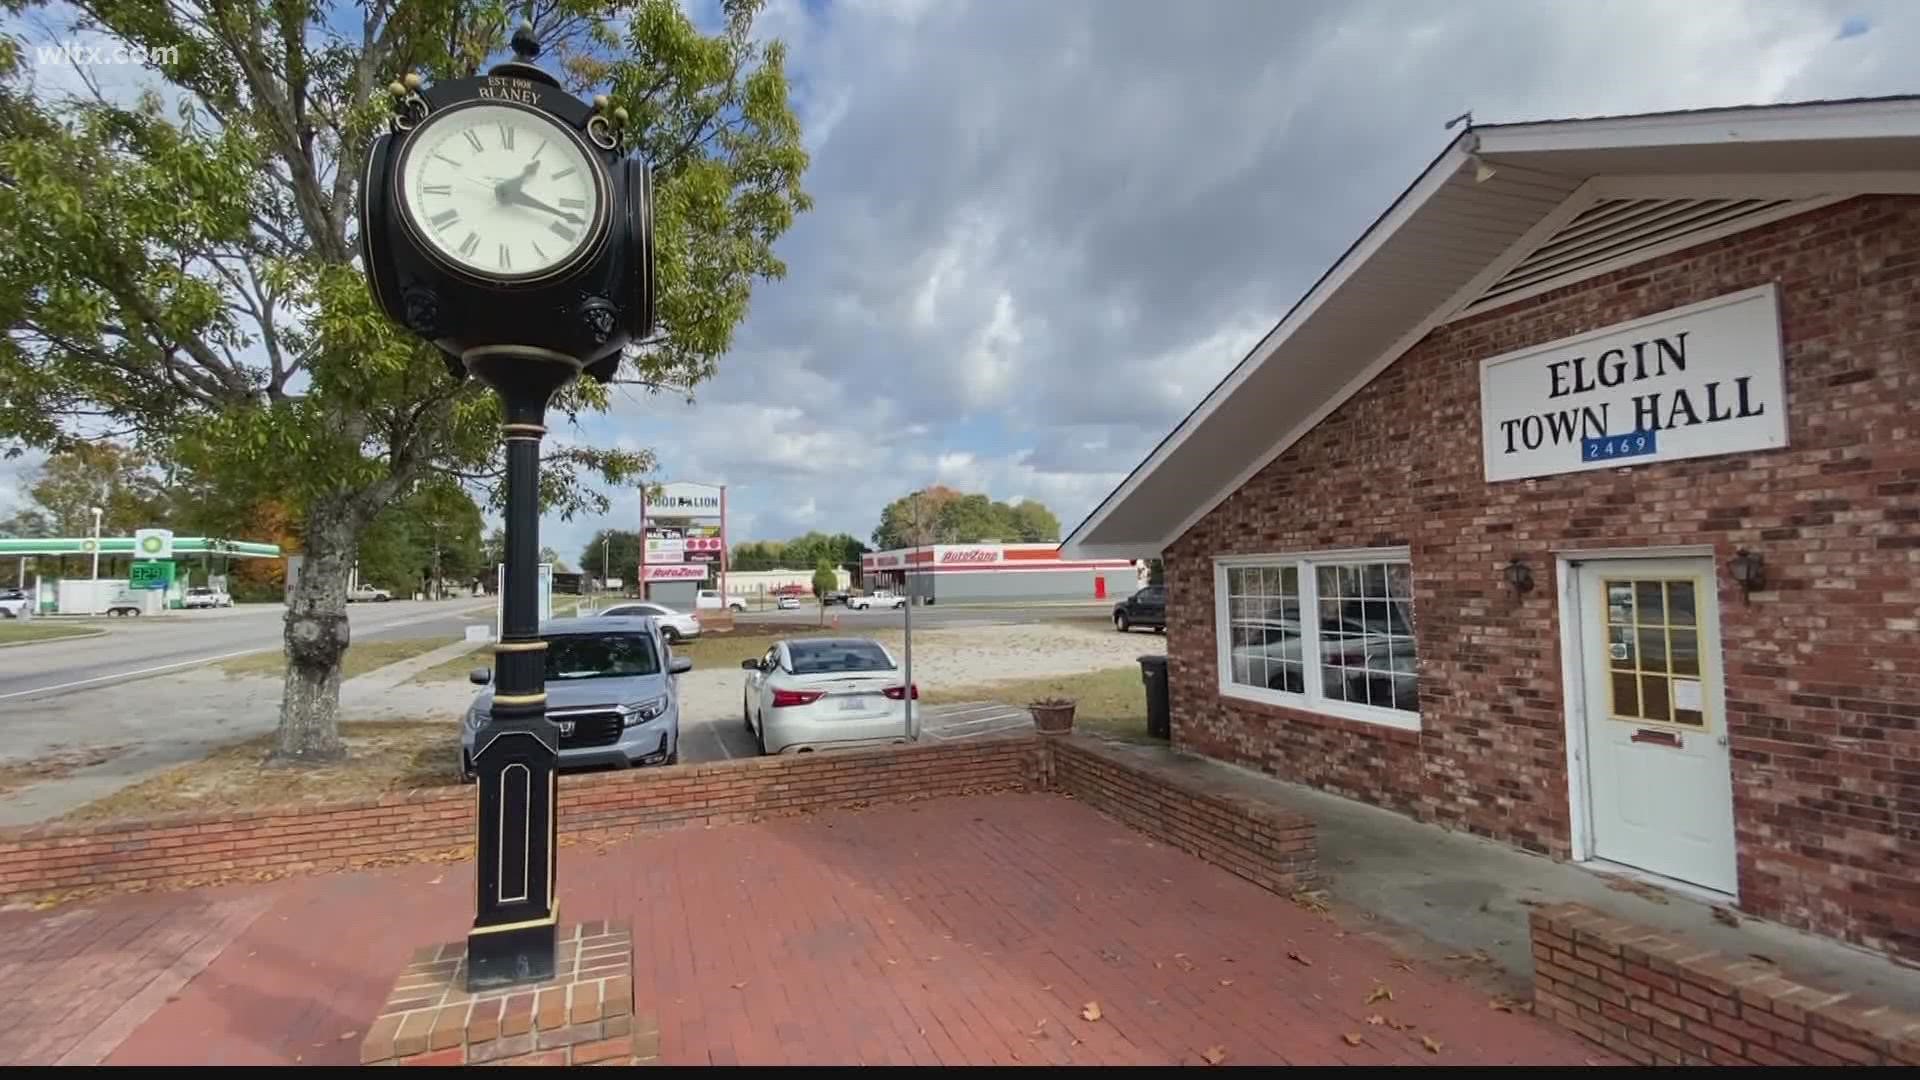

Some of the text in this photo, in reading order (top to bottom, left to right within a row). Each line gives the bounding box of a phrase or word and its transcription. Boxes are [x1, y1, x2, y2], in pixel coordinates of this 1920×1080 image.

[479, 87, 541, 105] BLANEY
[1546, 332, 1690, 399] ELGIN
[1501, 376, 1765, 454] TOWN HALL
[1590, 437, 1646, 458] 2469
[694, 496, 719, 507] LION
[653, 567, 704, 577] AutoZone
